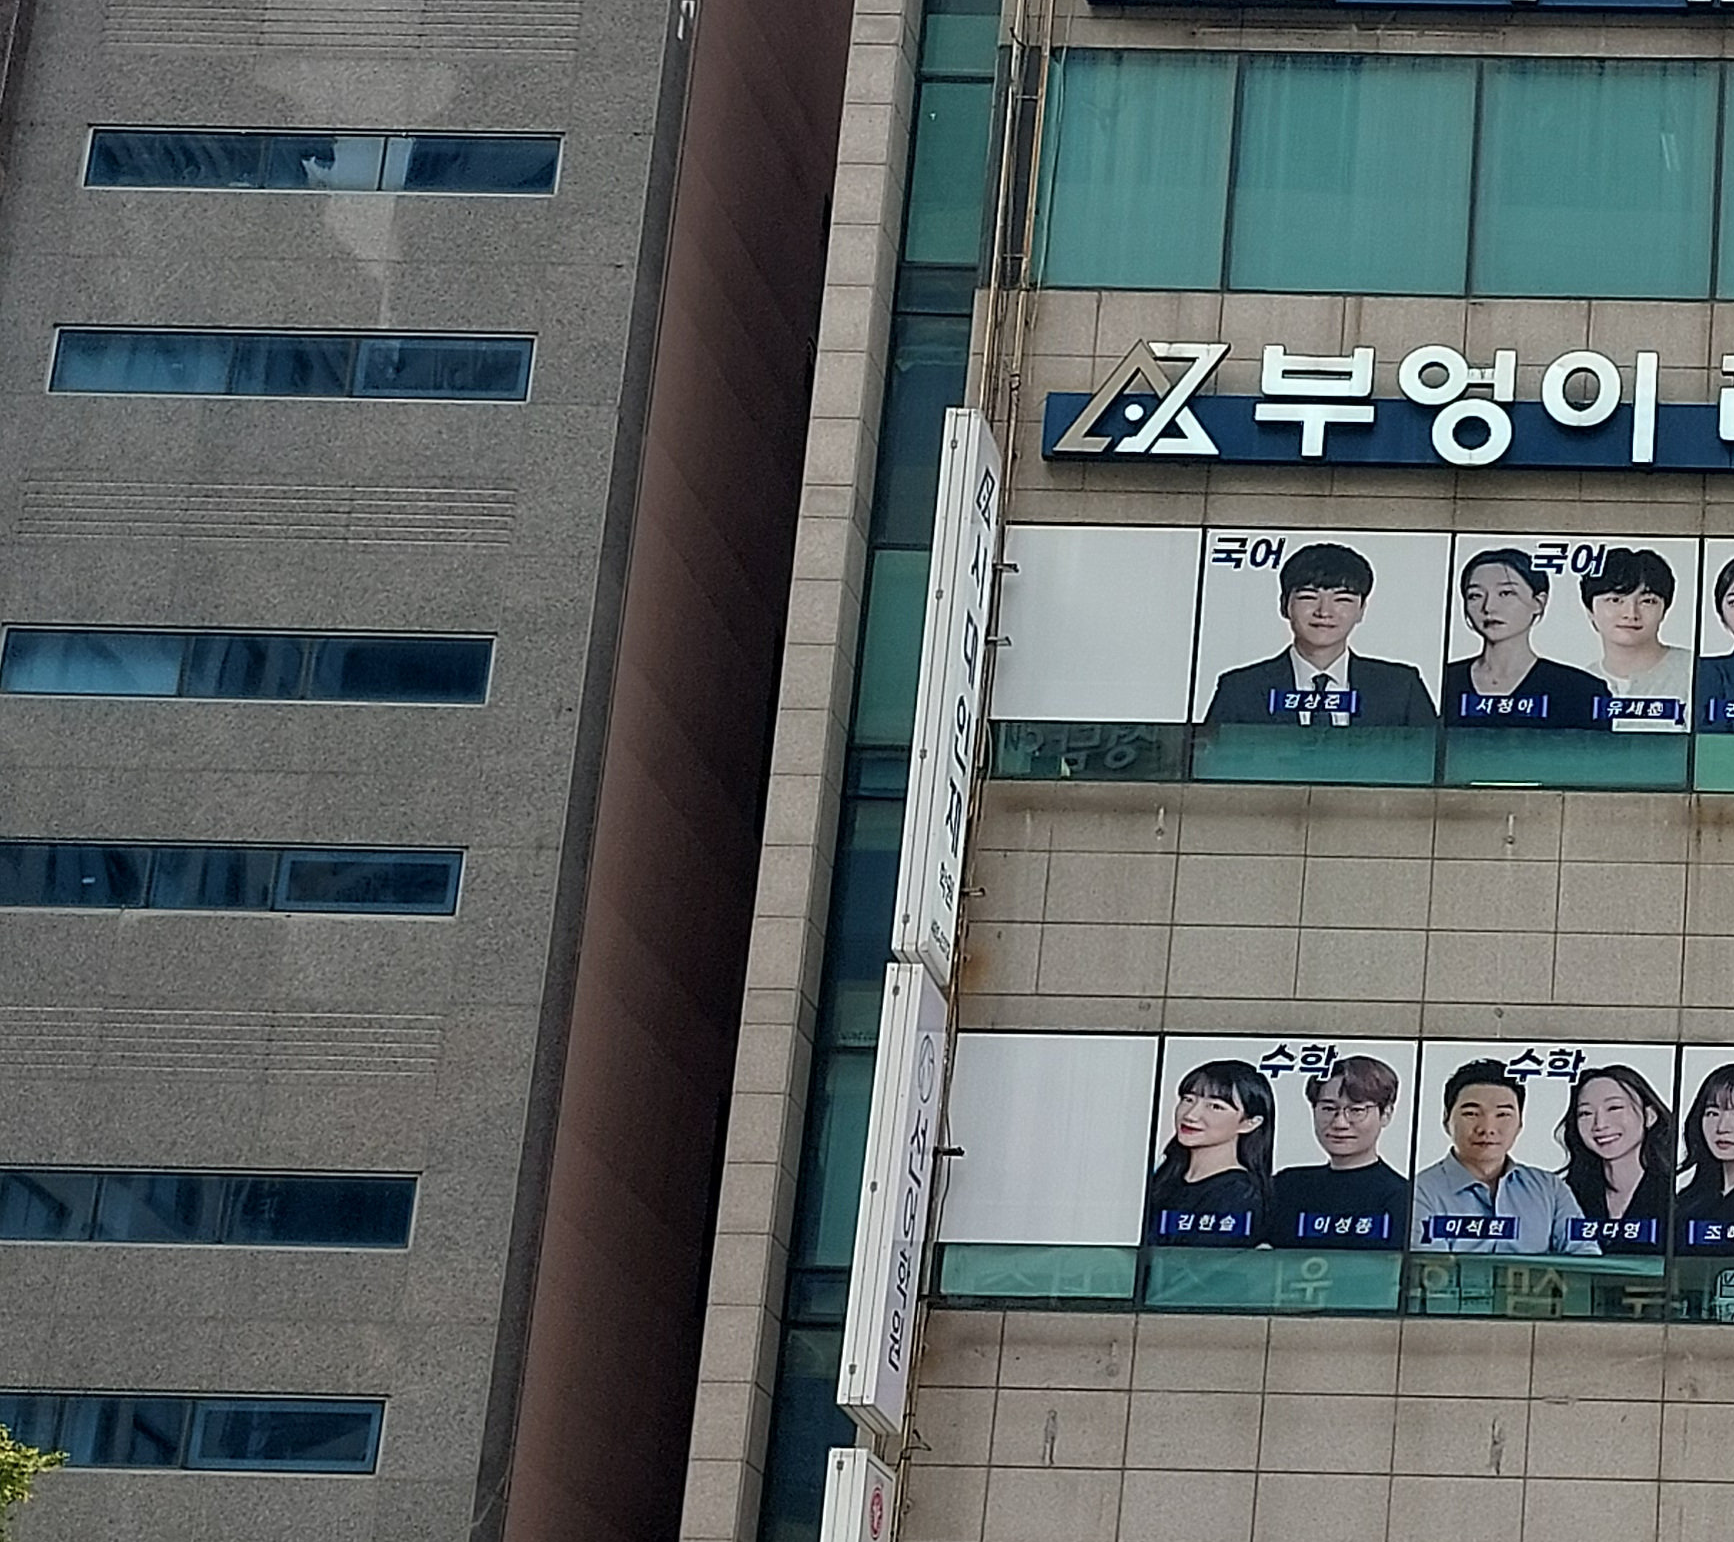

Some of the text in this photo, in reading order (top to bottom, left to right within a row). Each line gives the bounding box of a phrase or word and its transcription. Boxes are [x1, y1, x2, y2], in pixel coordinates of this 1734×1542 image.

[1254, 343, 1658, 468] 부엉이
[1211, 536, 1285, 570] 국어
[1531, 542, 1607, 576] 국어
[1258, 1044, 1338, 1081] 수학
[1505, 1048, 1587, 1085] 수학
